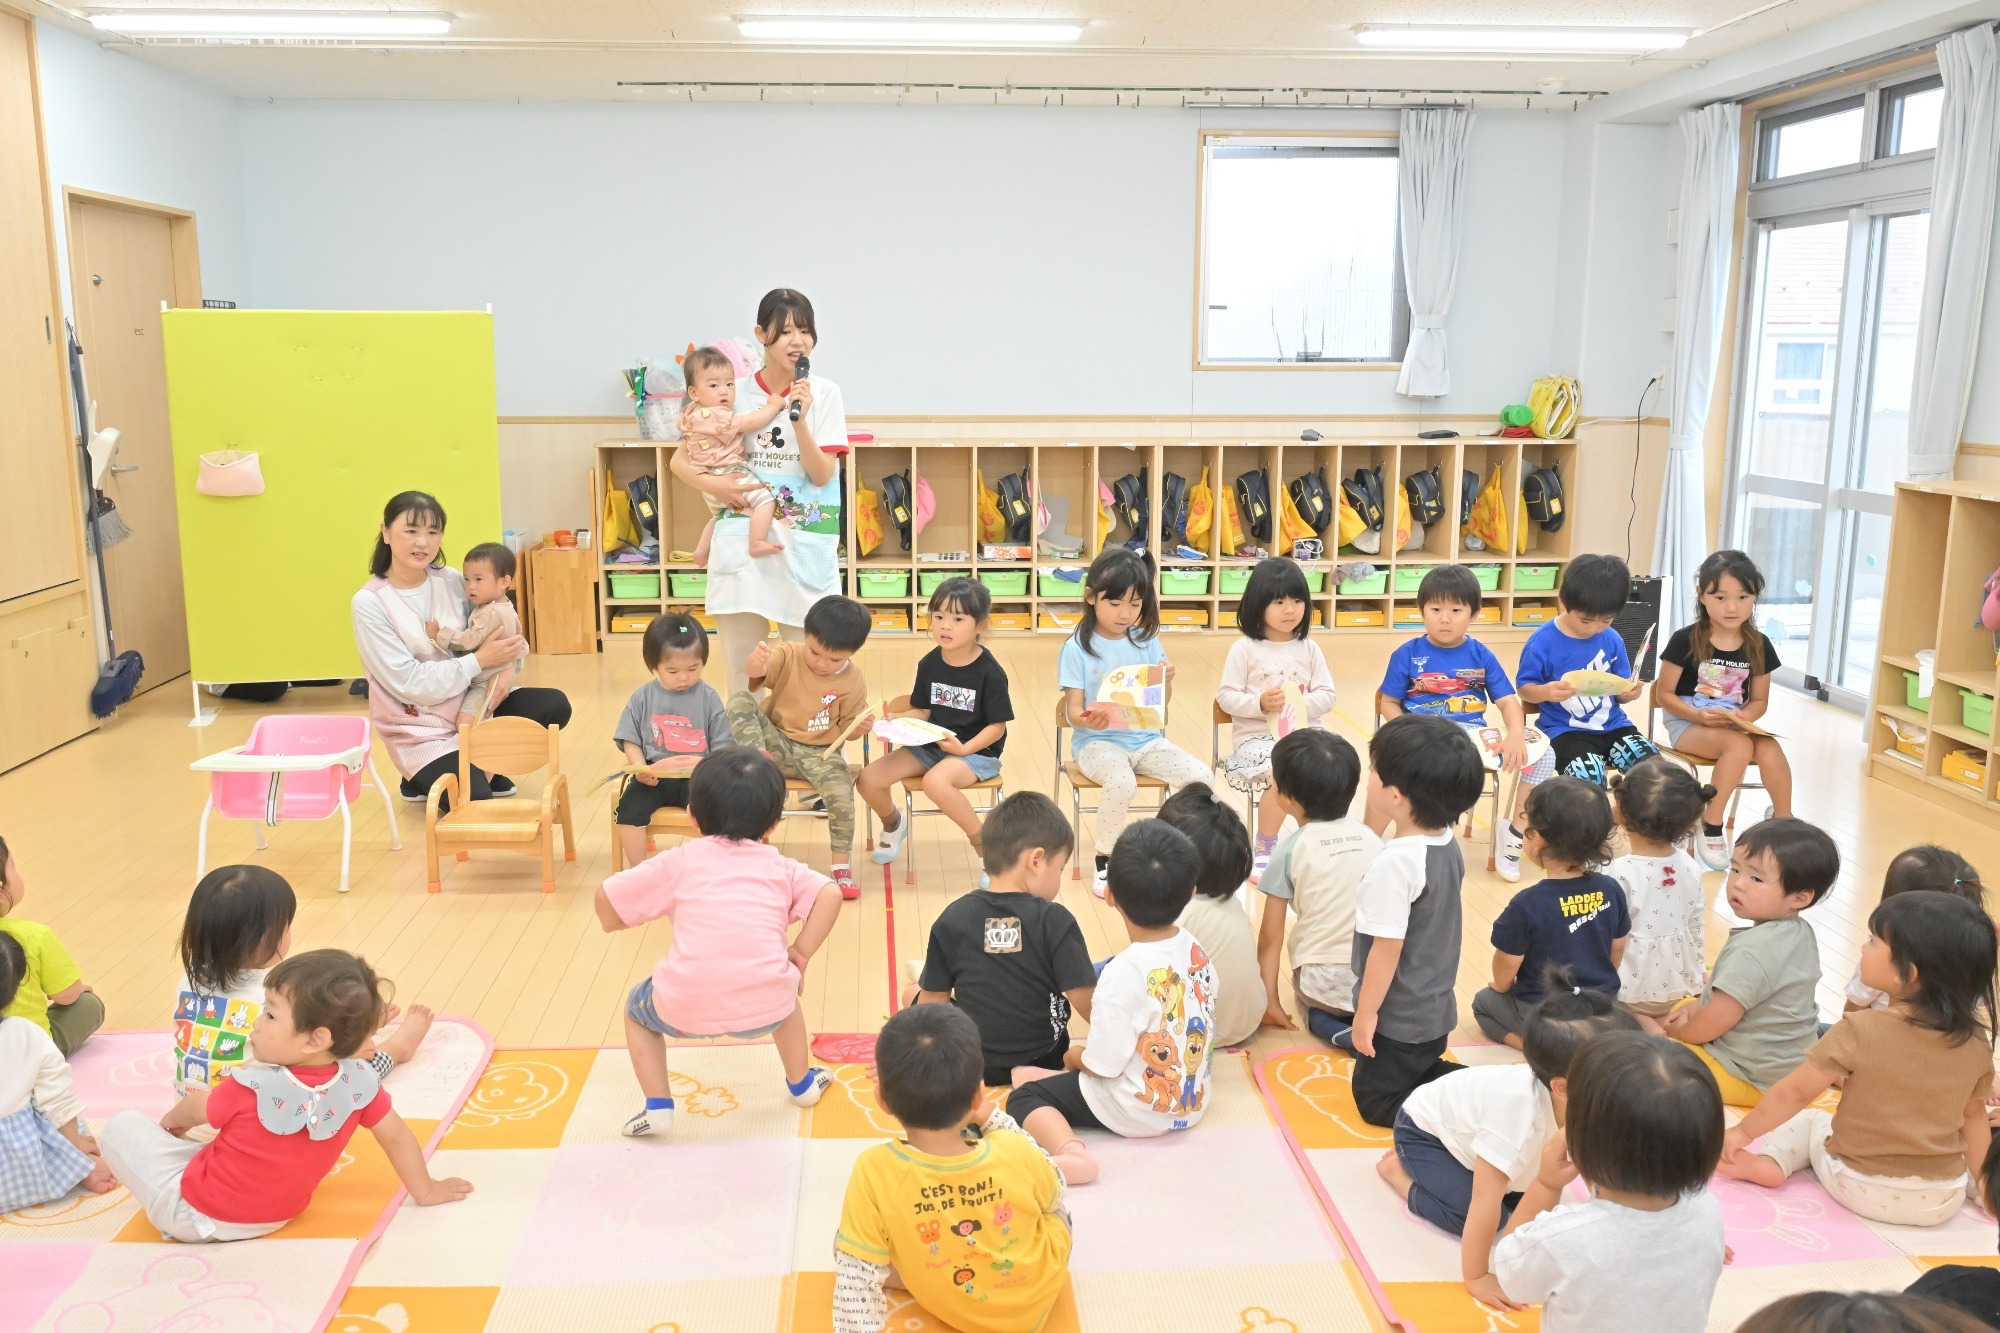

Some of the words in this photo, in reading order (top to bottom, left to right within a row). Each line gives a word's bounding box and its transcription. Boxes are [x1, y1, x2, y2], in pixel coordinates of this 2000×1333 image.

[766, 453, 800, 461] MOUSE'S
[754, 460, 781, 468] PICNIC
[935, 688, 971, 706] ROXY
[808, 717, 830, 727] PAW
[1559, 891, 1604, 906] LADDER
[1561, 900, 1604, 918] TRUCK
[1173, 1119, 1188, 1128] PAW
[921, 1183, 954, 1199] C'EST
[941, 1198, 955, 1210] DE
